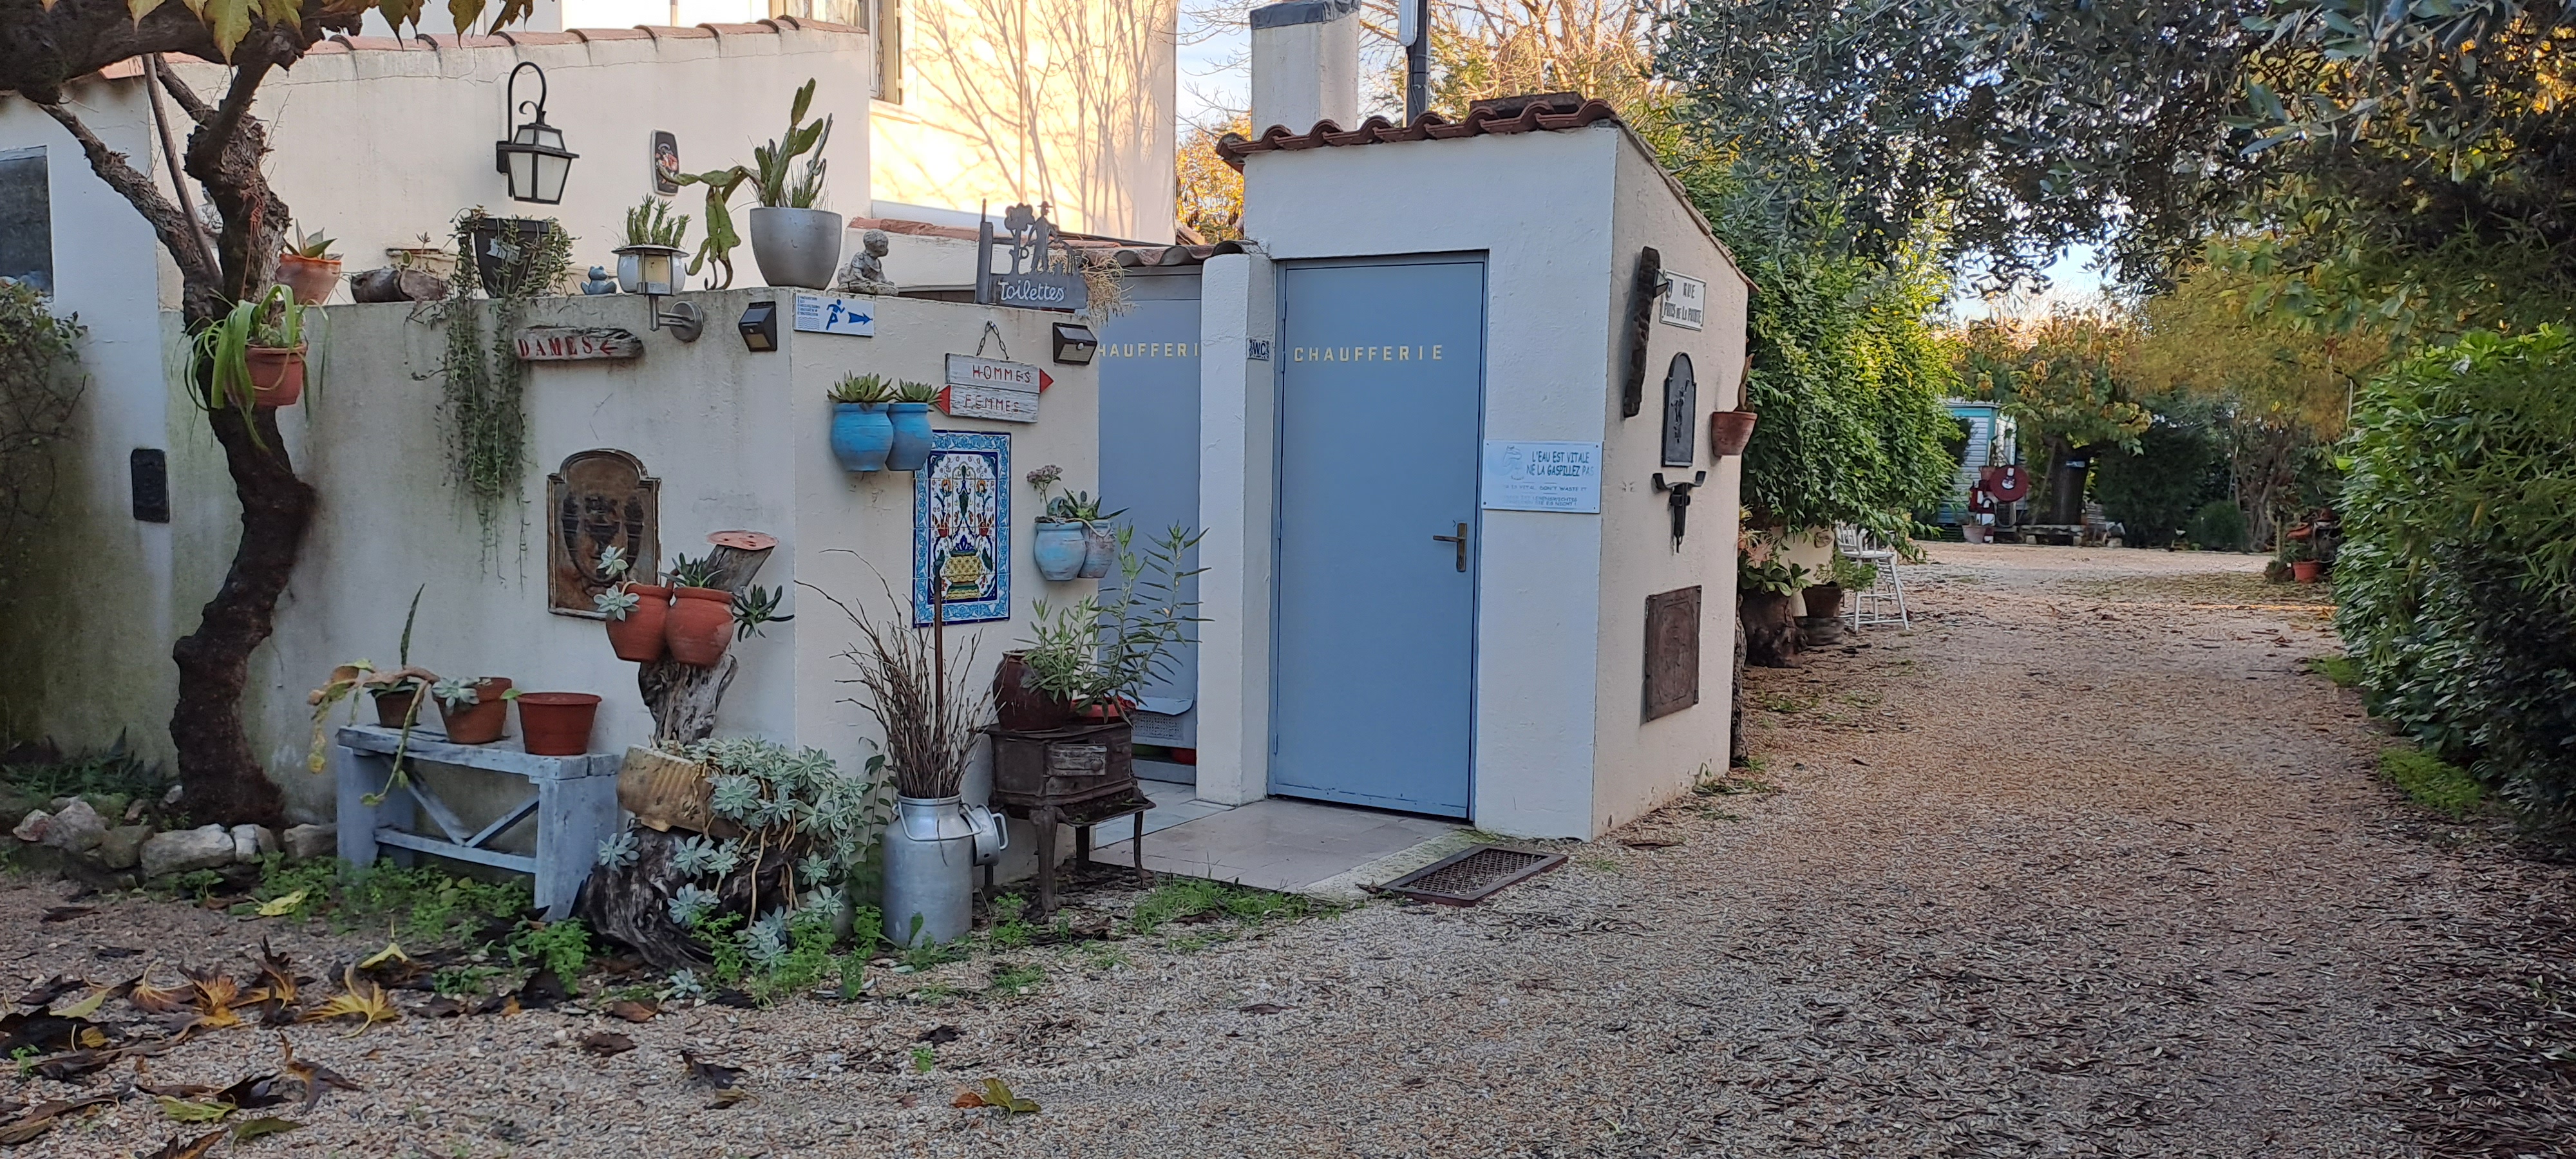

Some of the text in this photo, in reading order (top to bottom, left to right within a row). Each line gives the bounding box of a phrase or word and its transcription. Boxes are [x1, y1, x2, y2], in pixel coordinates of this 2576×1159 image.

[998, 279, 1065, 303] Toilettes
[1683, 282, 1696, 299] RUE
[517, 336, 593, 357] DAMES
[1098, 343, 1198, 357] HAUFFERI
[1294, 344, 1443, 362] CHAUFFERIE
[972, 364, 1031, 383] HOMMES
[965, 394, 1019, 412] FEMMES
[1532, 451, 1589, 464] L'EAU EST VITALE
[1526, 464, 1595, 476] NE LA GASPILLEZ PAS
